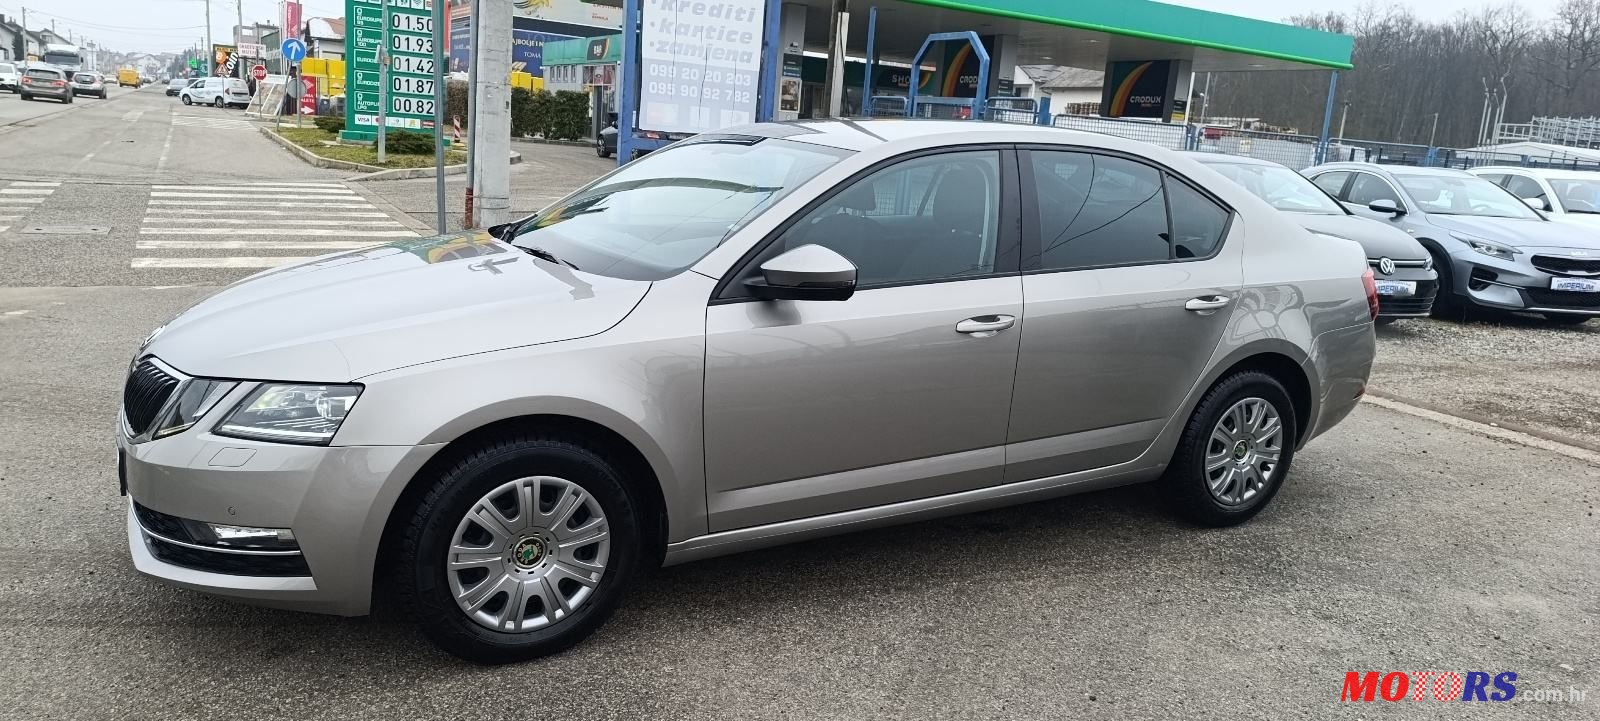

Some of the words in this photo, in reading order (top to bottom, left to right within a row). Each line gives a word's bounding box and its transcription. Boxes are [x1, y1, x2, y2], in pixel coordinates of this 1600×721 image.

[660, 0, 756, 22] krediti
[392, 14, 433, 33] 01.50
[658, 17, 753, 45] kartice
[392, 35, 433, 53] 01.93
[512, 38, 535, 47] AJBOLJE
[655, 39, 753, 64] zamjena
[253, 69, 265, 77] STOP
[393, 57, 434, 74] 01.42
[649, 63, 677, 79] 099
[681, 67, 699, 81] 20
[704, 70, 722, 83] 20
[725, 72, 752, 87] 203
[892, 74, 912, 85] SHO
[959, 75, 978, 84] CROD
[393, 77, 434, 94] 01.87
[679, 84, 698, 98] 90
[702, 87, 721, 101] 92
[724, 89, 751, 104] 782
[393, 97, 434, 115] 00.82
[1129, 95, 1162, 104] CRODUX
[1557, 282, 1595, 290] IMPERIUM
